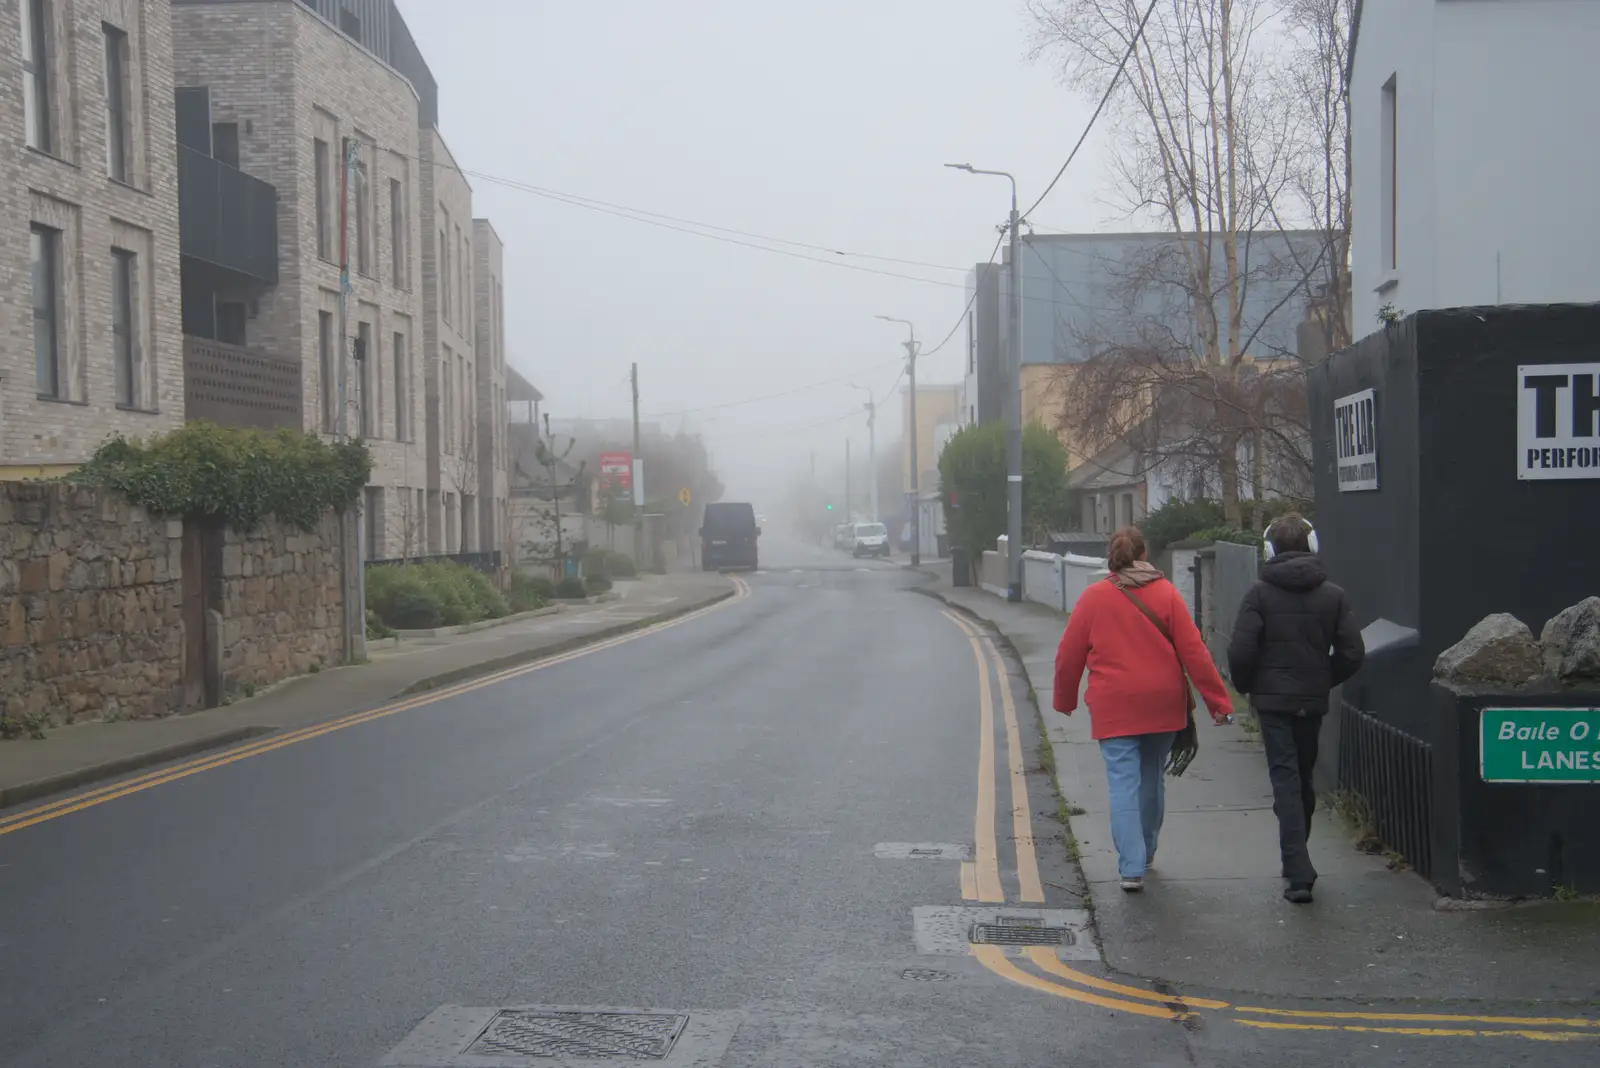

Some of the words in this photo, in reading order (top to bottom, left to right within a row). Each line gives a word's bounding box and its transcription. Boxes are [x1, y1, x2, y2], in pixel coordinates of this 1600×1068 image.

[1336, 404, 1355, 458] THE
[1355, 398, 1374, 455] LAB
[1498, 720, 1560, 741] Baile
[1569, 721, 1590, 741] O
[1521, 750, 1600, 770] LANES
